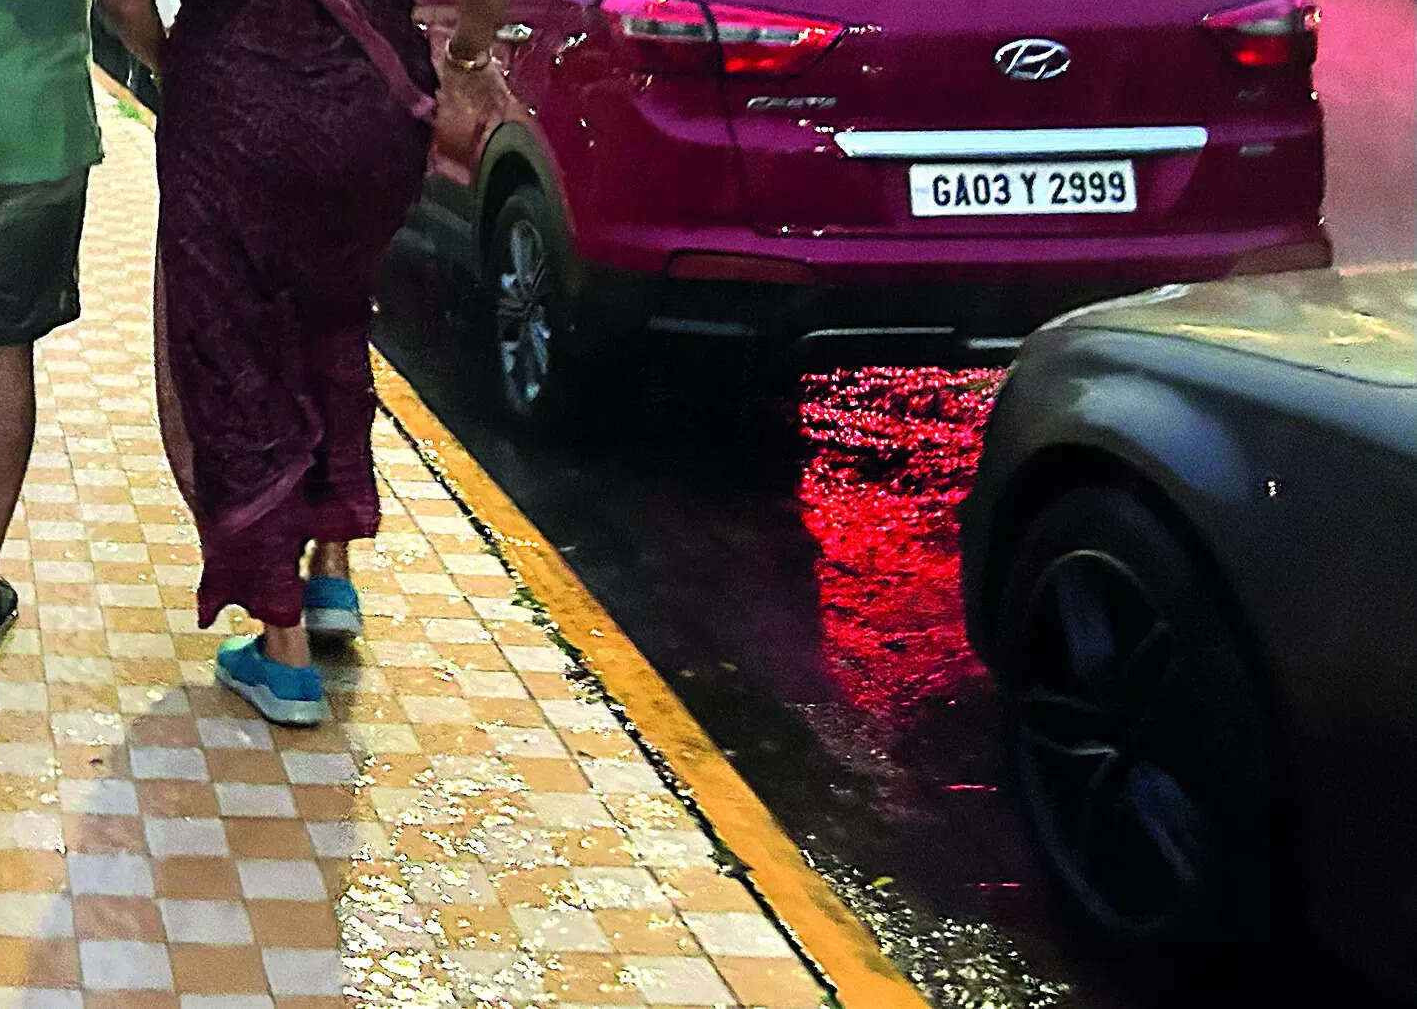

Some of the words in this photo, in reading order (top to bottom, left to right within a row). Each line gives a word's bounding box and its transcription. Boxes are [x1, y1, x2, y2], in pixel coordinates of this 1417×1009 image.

[932, 173, 1012, 207] GA03
[1019, 170, 1038, 205] Y
[1048, 170, 1128, 205] 2999
